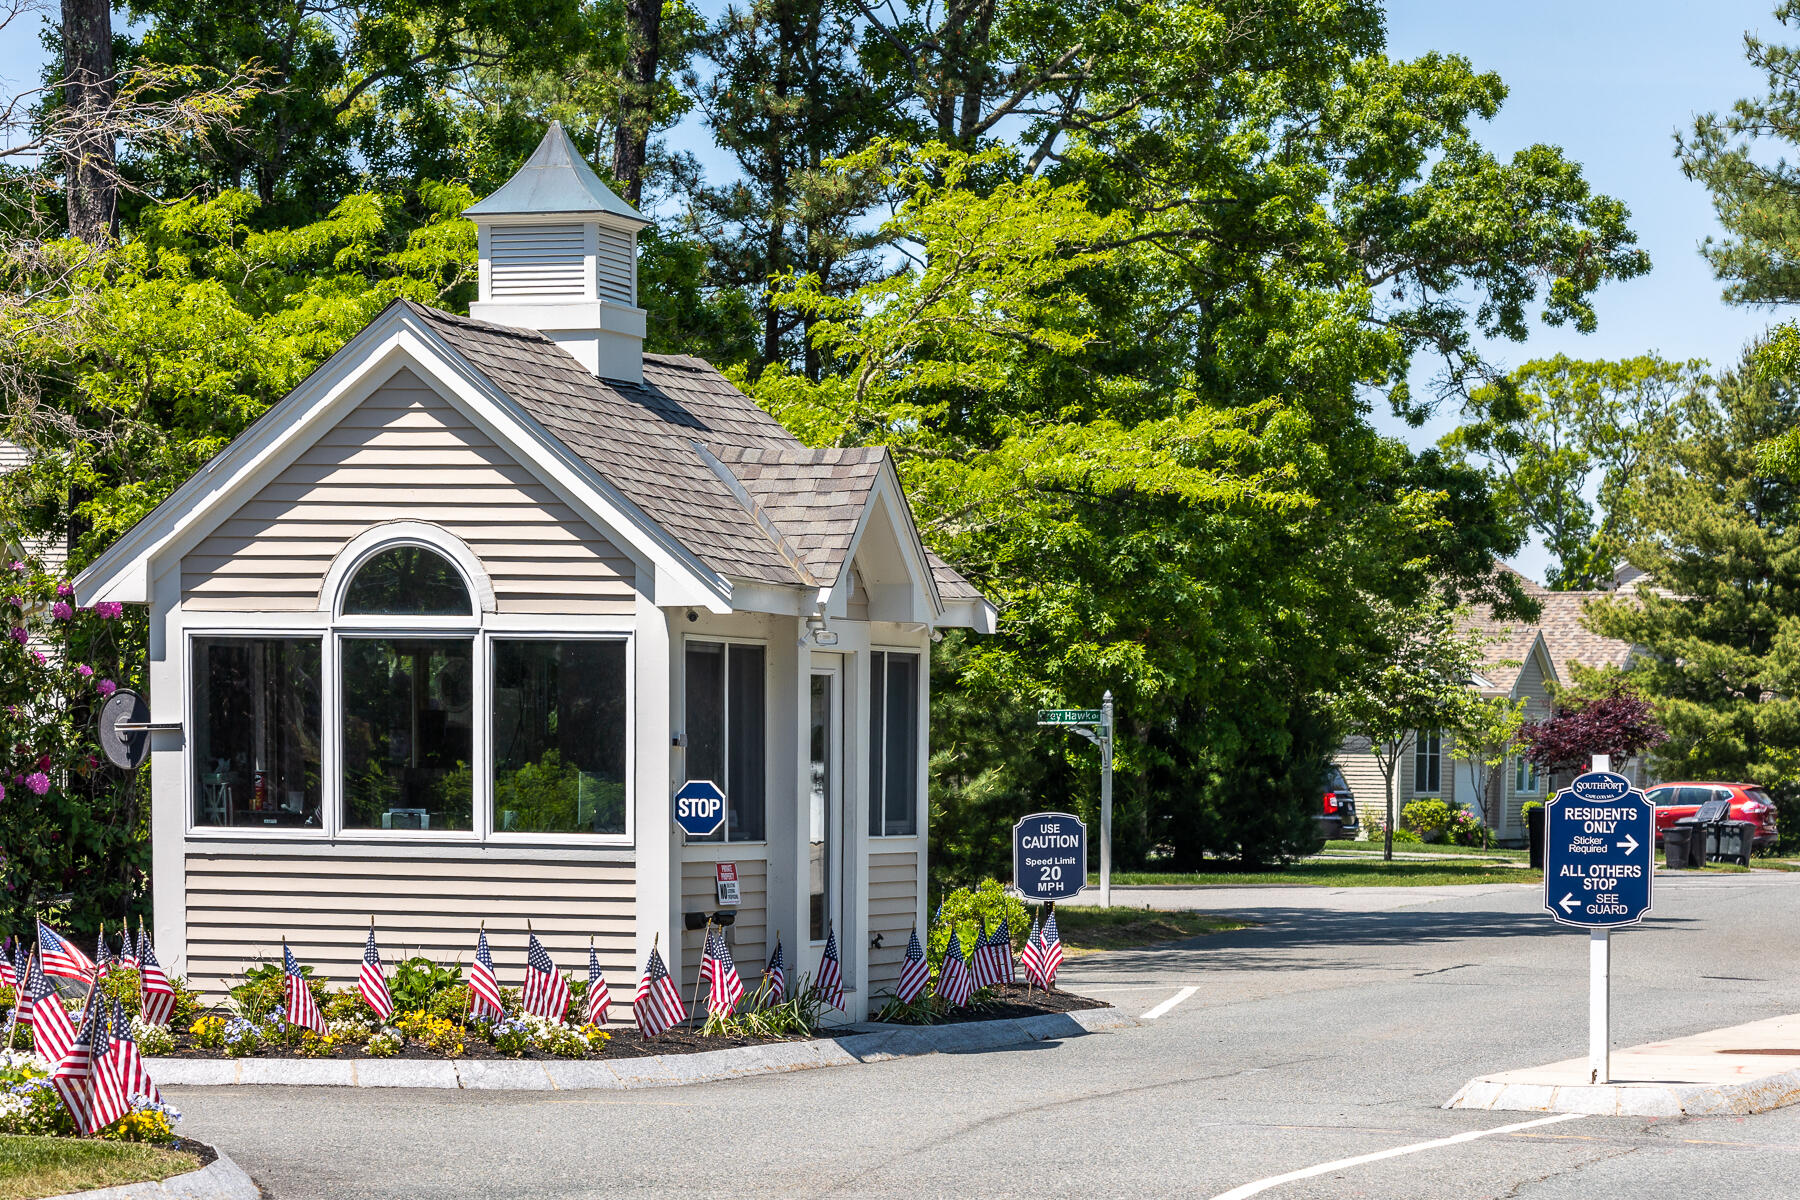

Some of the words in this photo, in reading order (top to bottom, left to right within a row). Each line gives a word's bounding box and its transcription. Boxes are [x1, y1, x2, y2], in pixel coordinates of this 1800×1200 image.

[1064, 711, 1091, 720] Hawk
[1576, 781, 1624, 793] SOUTHPORT
[678, 798, 721, 818] STOP
[1564, 807, 1637, 821] RESIDENTS
[1040, 823, 1060, 834] USE
[1584, 821, 1617, 834] ONLY
[1022, 835, 1079, 849] CAUTION
[1573, 835, 1603, 845] Sticker
[1568, 844, 1608, 854] Required
[1025, 857, 1053, 867] Speed
[1054, 856, 1076, 865] Limit
[1040, 866, 1062, 881] 20
[1560, 864, 1585, 877] ALL
[1589, 864, 1642, 878] OTHERS
[1037, 882, 1064, 892] MPH
[1583, 878, 1618, 891] STOP
[1596, 893, 1619, 904] SEE
[1586, 904, 1628, 915] GUARD
